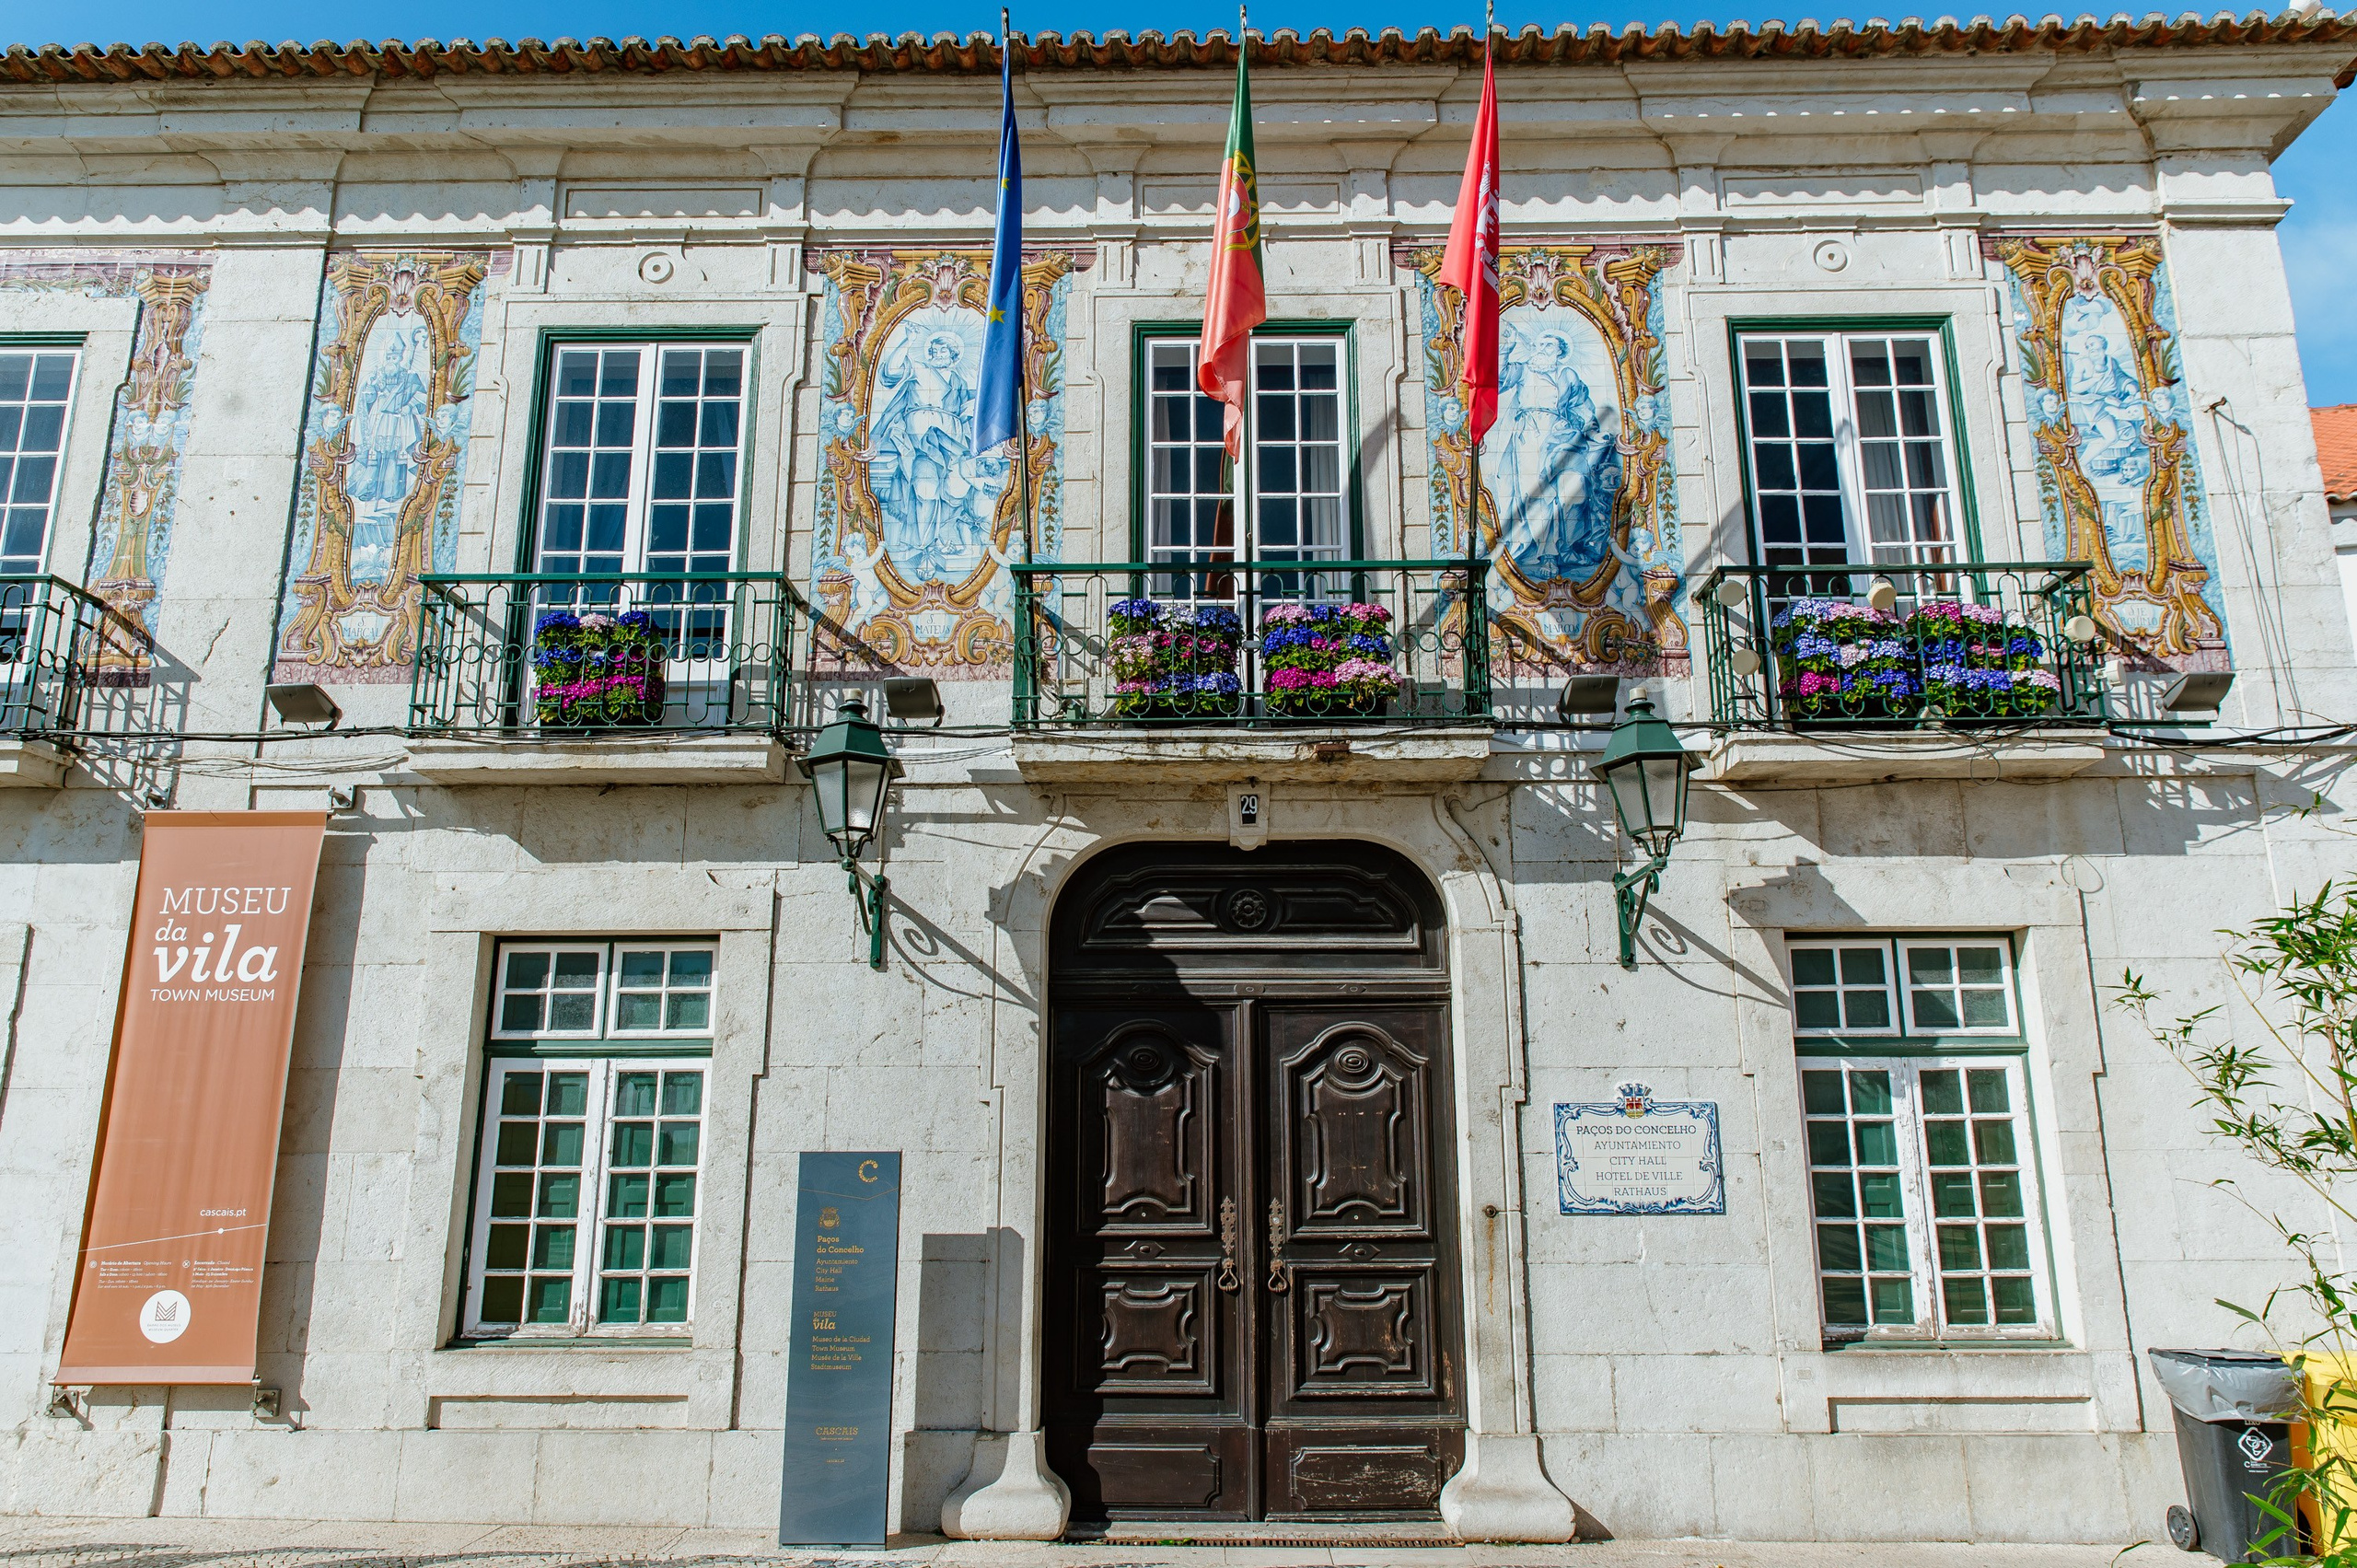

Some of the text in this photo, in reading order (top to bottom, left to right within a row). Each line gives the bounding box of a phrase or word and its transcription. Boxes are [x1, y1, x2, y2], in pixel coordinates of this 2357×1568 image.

[915, 624, 951, 634] MATEUS
[1240, 795, 1258, 815] 29
[158, 887, 292, 915] MUSEU
[155, 918, 187, 942] da
[153, 923, 278, 983] vila
[150, 988, 275, 1002] TOWN MUSEUM
[1576, 1125, 1697, 1136] PAÇOS DO CONCELHO
[1594, 1141, 1681, 1150] AYUNTAMIENTO
[1609, 1156, 1667, 1166] CITY HALL
[1596, 1171, 1683, 1181] HOTEL DE VILLE
[1614, 1187, 1667, 1196] RATHAUS
[200, 1207, 247, 1217] cascais.pt
[817, 1235, 840, 1244] Paços
[816, 1258, 858, 1266] Ayuntamiento
[813, 1318, 836, 1330] vila
[816, 1426, 859, 1435] CASCAIS
